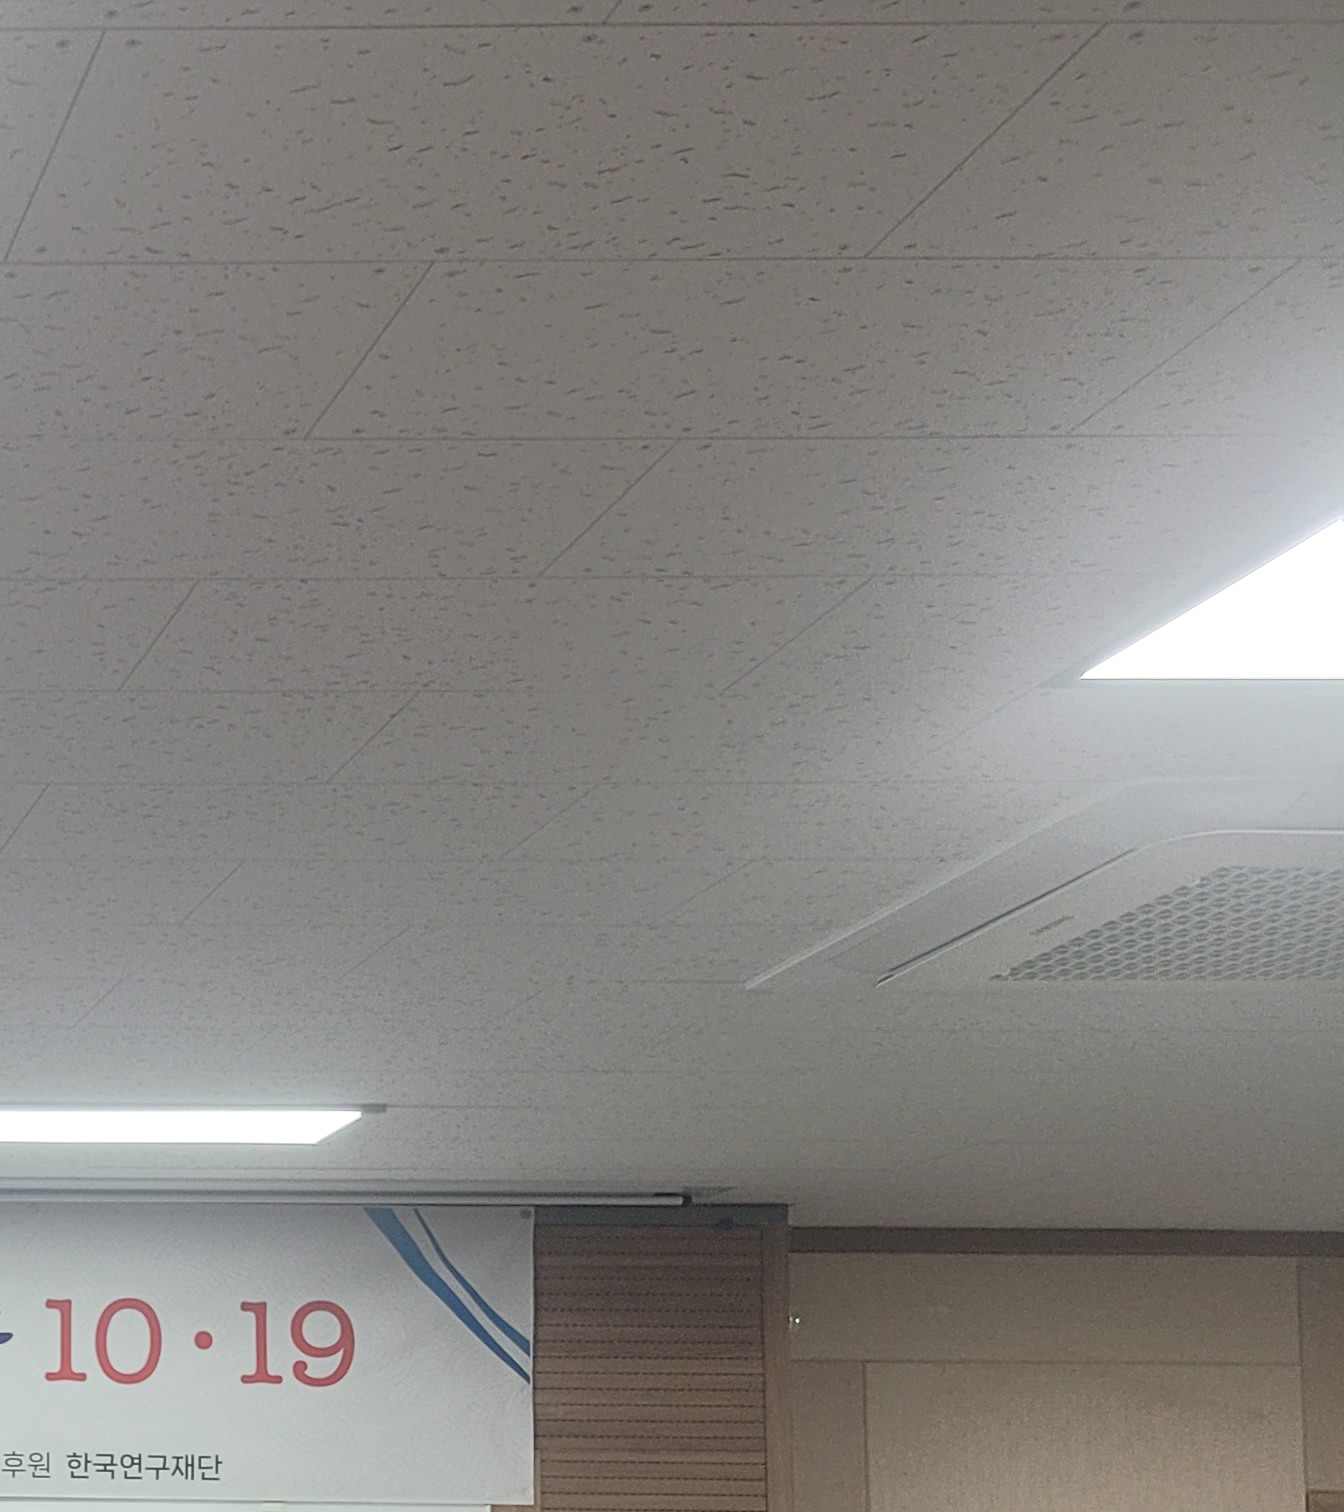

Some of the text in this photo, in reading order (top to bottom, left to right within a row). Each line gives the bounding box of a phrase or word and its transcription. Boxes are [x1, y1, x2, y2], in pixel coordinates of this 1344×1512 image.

[45, 1297, 356, 1387] 10·19
[2, 1451, 222, 1480] 후원 한국연구재단
